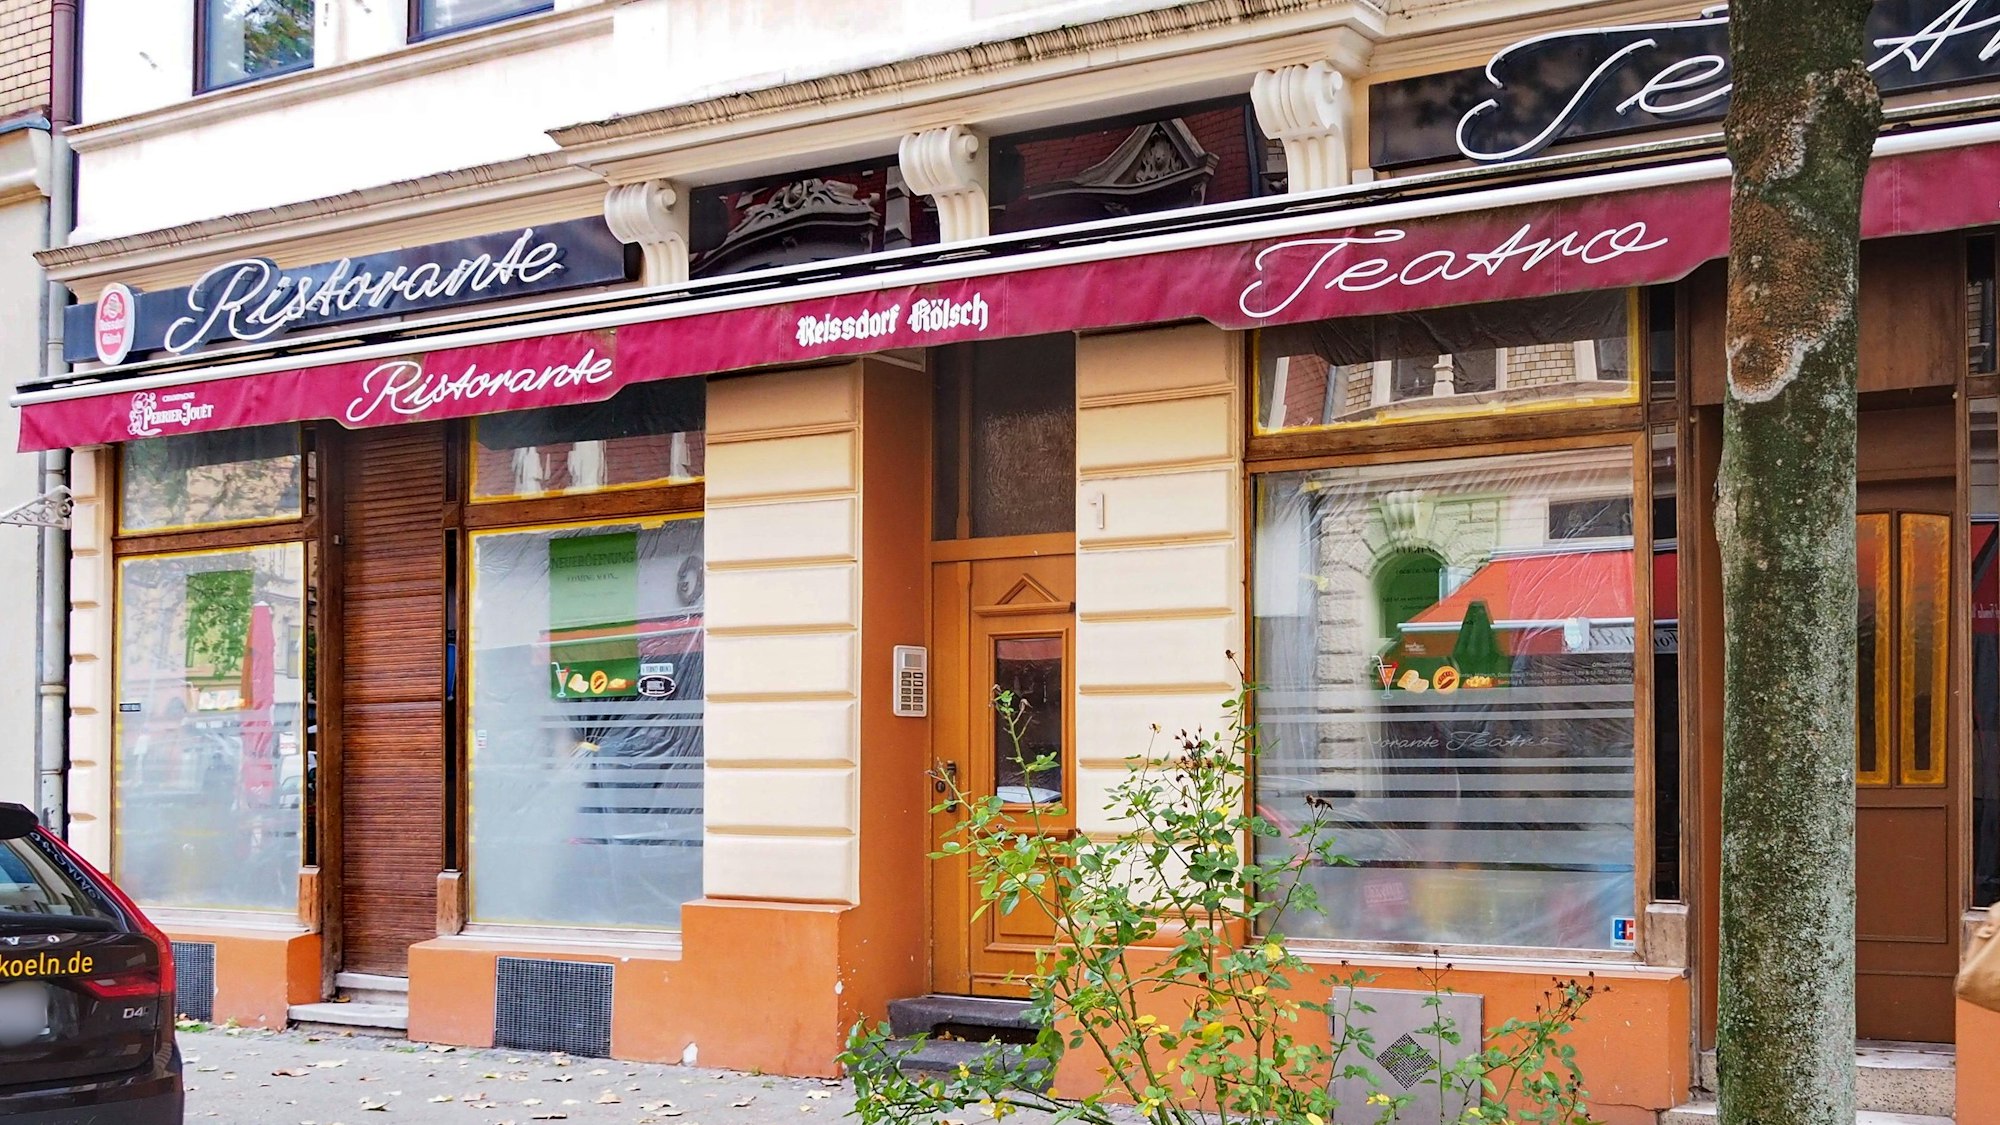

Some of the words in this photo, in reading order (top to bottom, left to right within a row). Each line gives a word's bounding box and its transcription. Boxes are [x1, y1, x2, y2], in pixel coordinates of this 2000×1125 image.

[163, 228, 561, 354] Ristorante
[1239, 221, 1668, 318] Teatro
[796, 303, 900, 347] Reissdorf
[907, 292, 989, 333] Kölsch
[346, 348, 613, 421] Ristorante
[0, 951, 93, 977] koeln.de
